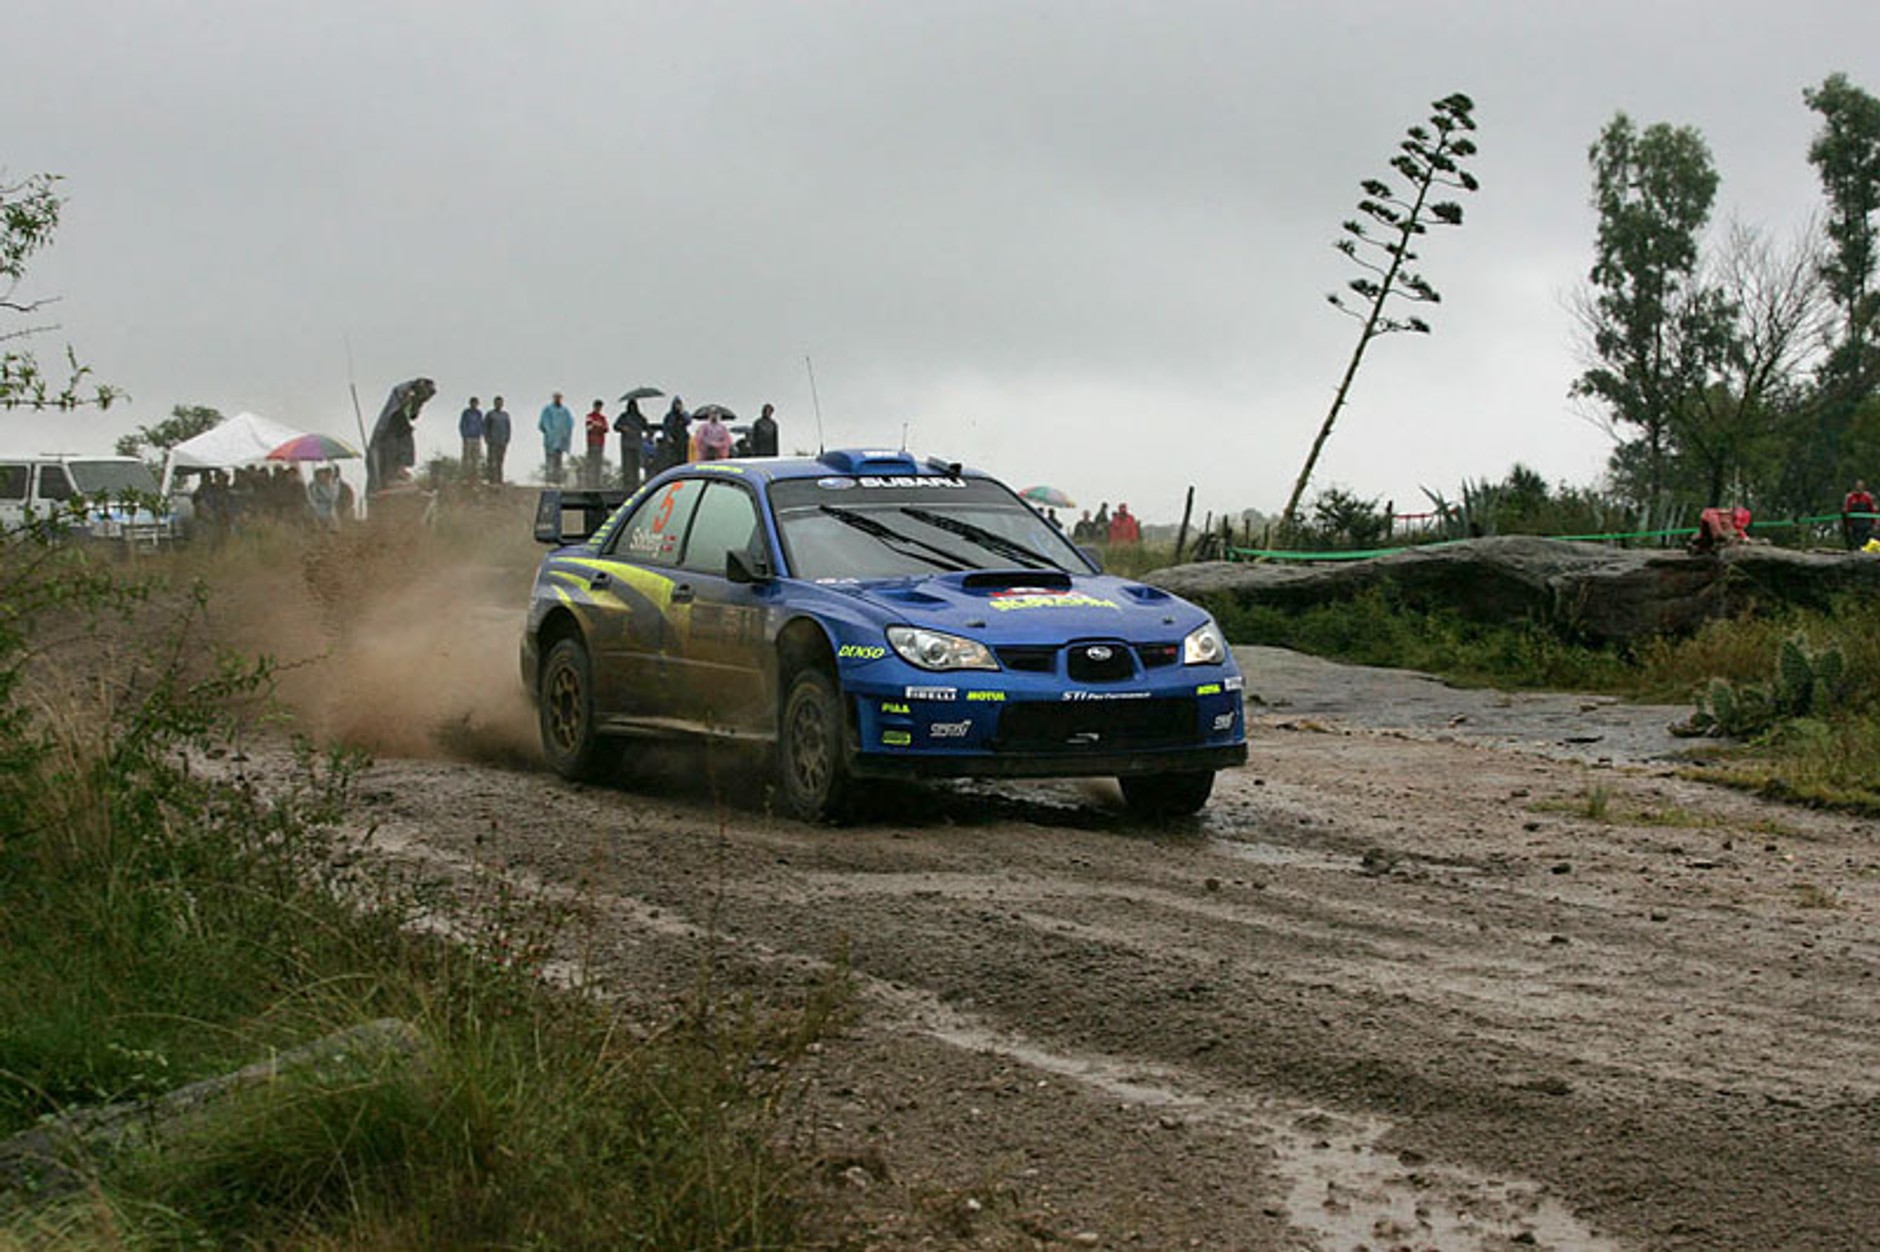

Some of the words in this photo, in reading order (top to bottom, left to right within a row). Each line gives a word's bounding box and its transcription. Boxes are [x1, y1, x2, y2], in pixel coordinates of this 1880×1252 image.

[651, 481, 684, 534] 5
[838, 644, 885, 660] DENSO
[966, 691, 1007, 701] MOTUL
[1062, 690, 1087, 701] STI
[1087, 691, 1151, 700] Performance
